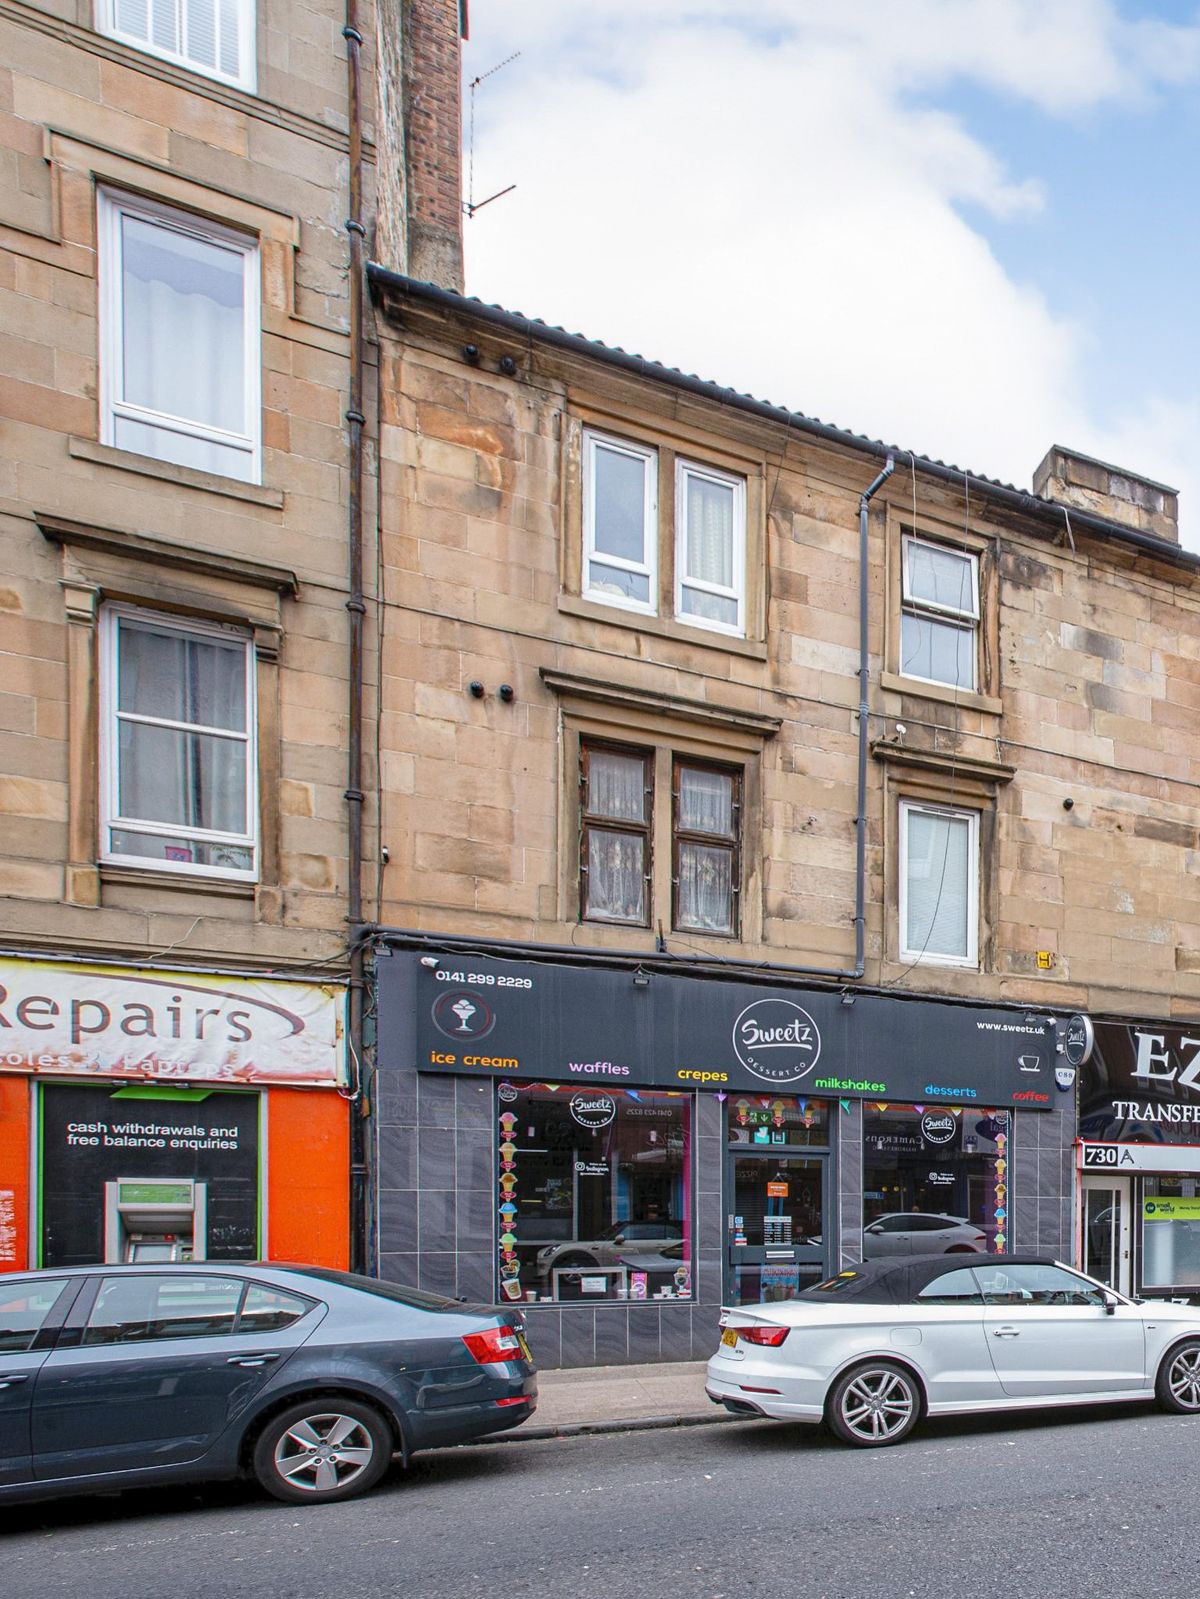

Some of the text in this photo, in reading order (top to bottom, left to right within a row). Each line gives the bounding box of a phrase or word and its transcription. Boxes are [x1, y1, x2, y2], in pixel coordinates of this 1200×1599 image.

[435, 970, 533, 989] 0141 299 2229
[741, 1018, 814, 1045] Sweetz
[976, 1020, 1046, 1036] www.sweetz.uk
[430, 1050, 519, 1069] ice cream
[747, 1056, 791, 1077] DESSERT
[568, 1060, 631, 1076] waffles
[677, 1068, 729, 1083] crepes
[815, 1076, 887, 1093] milkshakes
[924, 1083, 978, 1098] desserts
[574, 1097, 612, 1111] Sweetz
[1012, 1090, 1049, 1103] coffee
[67, 1121, 239, 1138] cash withdrawals and
[67, 1134, 239, 1150] free balance enquiries
[1086, 1147, 1117, 1164] 730
